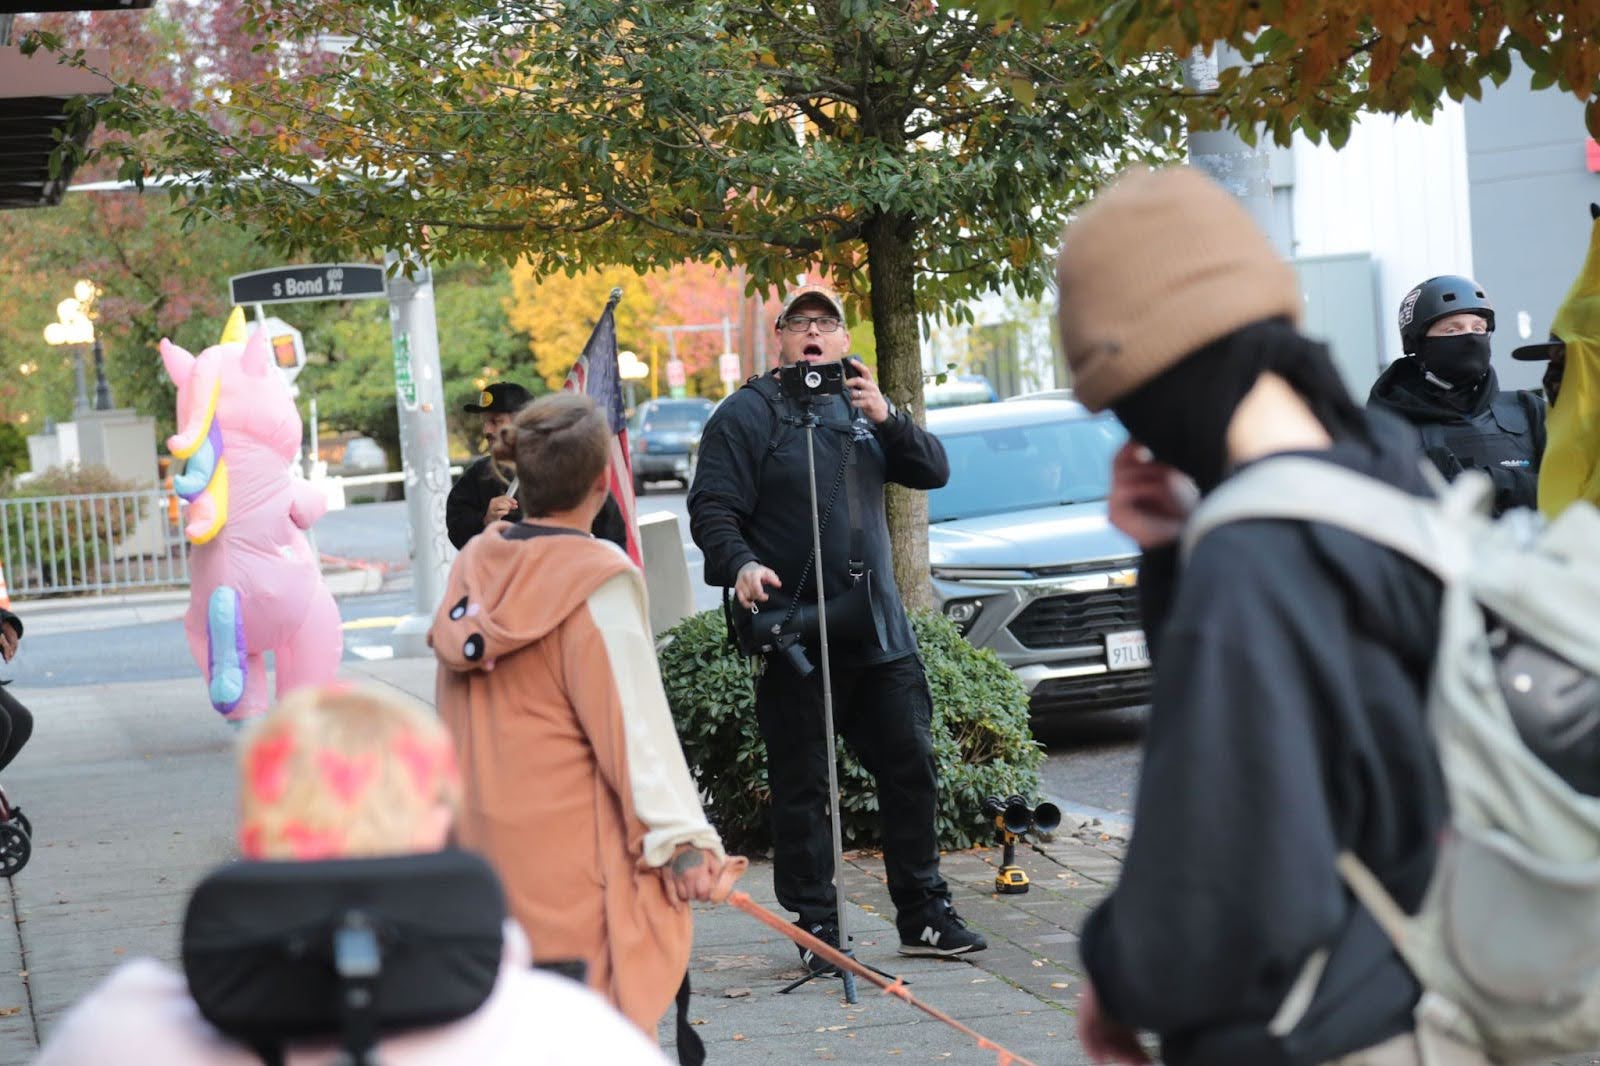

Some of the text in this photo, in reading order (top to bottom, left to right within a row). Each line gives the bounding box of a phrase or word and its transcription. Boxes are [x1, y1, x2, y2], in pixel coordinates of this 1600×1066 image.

[285, 276, 323, 296] Bond
[328, 279, 343, 292] Av
[920, 925, 941, 946] N
